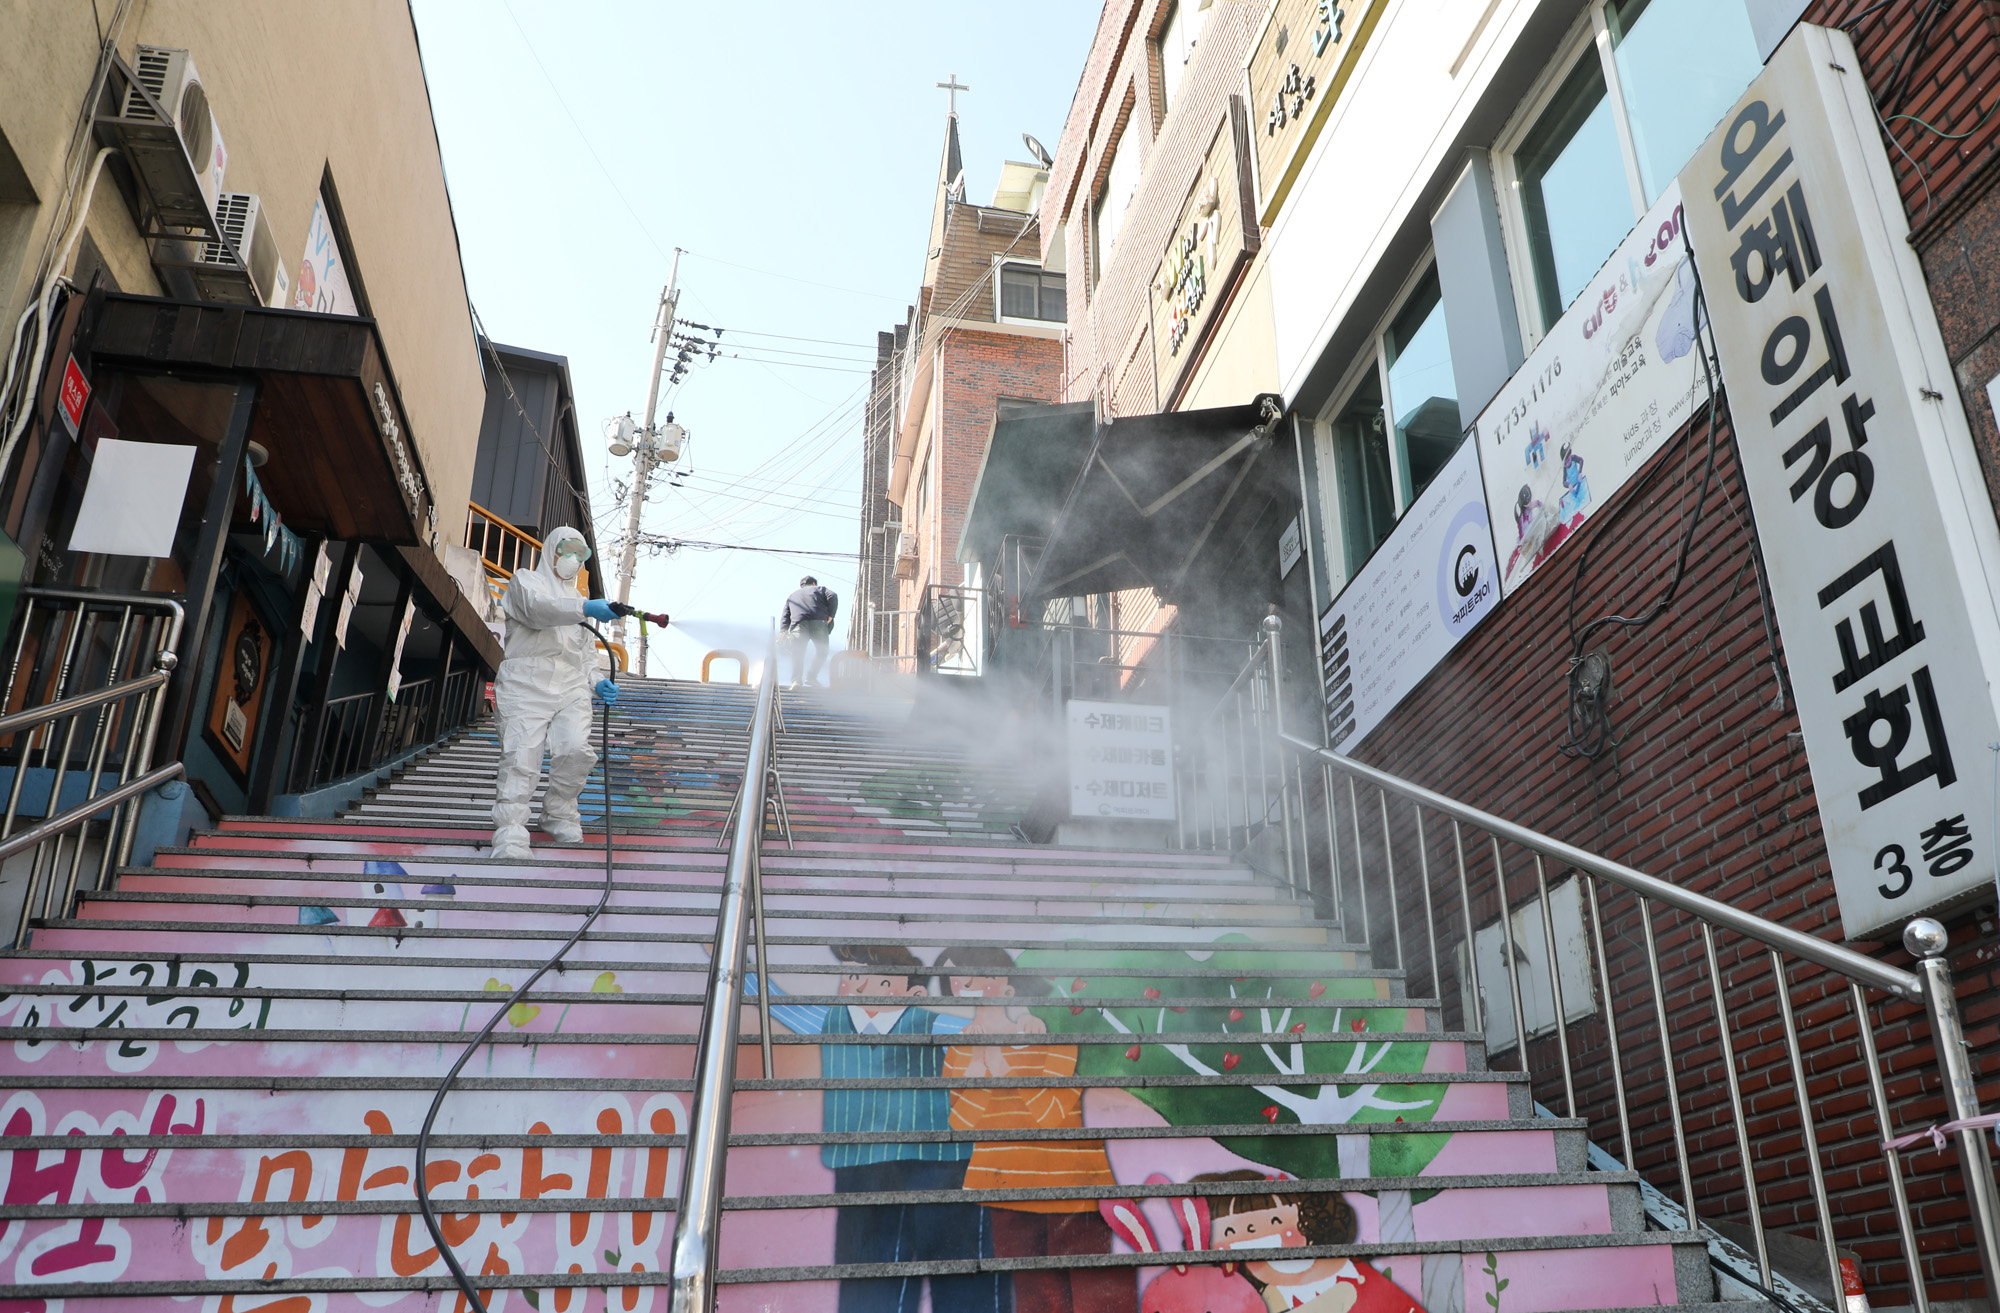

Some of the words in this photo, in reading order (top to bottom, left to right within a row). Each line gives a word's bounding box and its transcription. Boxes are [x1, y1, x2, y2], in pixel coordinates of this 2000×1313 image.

[1612, 336, 1642, 371] 미술교육
[1609, 354, 1646, 397] 피아노교육
[1623, 422, 1639, 443] kids
[1640, 399, 1658, 426] 과정
[1452, 580, 1491, 625] 커피트레이
[1086, 780, 1169, 799] 수제디저트
